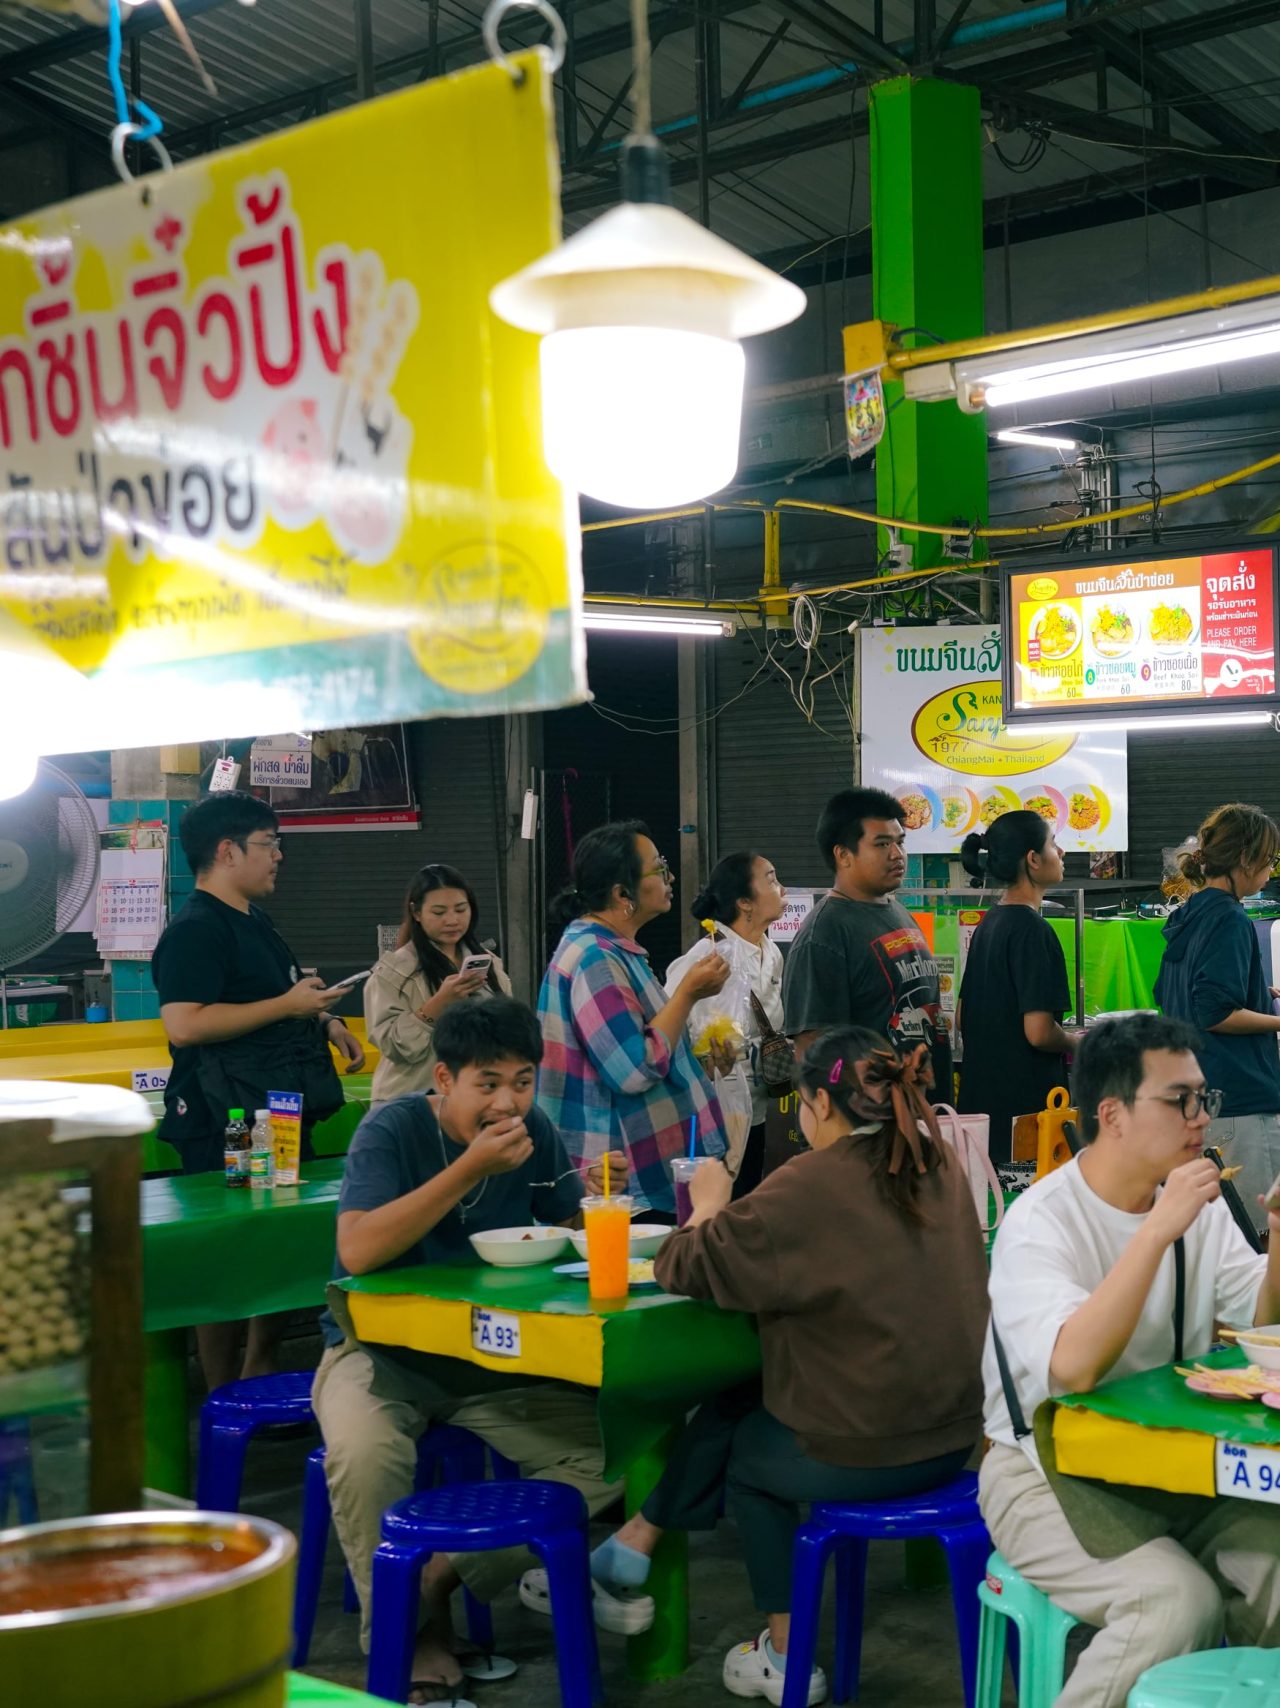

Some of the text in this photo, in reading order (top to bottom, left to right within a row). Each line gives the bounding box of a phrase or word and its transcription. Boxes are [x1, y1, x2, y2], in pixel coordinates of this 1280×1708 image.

[1206, 560, 1256, 600] จุดสั่ง
[1206, 625, 1257, 638] PLEASE ORDER
[1240, 637, 1257, 646] HERE
[897, 630, 1001, 673] ขนมจีนสั
[1181, 680, 1191, 691] 80
[931, 741, 969, 754] 1977
[1005, 753, 1045, 764] Thailand
[140, 1078, 148, 1089] A
[480, 1323, 514, 1349] A 93
[1232, 1460, 1251, 1488] A
